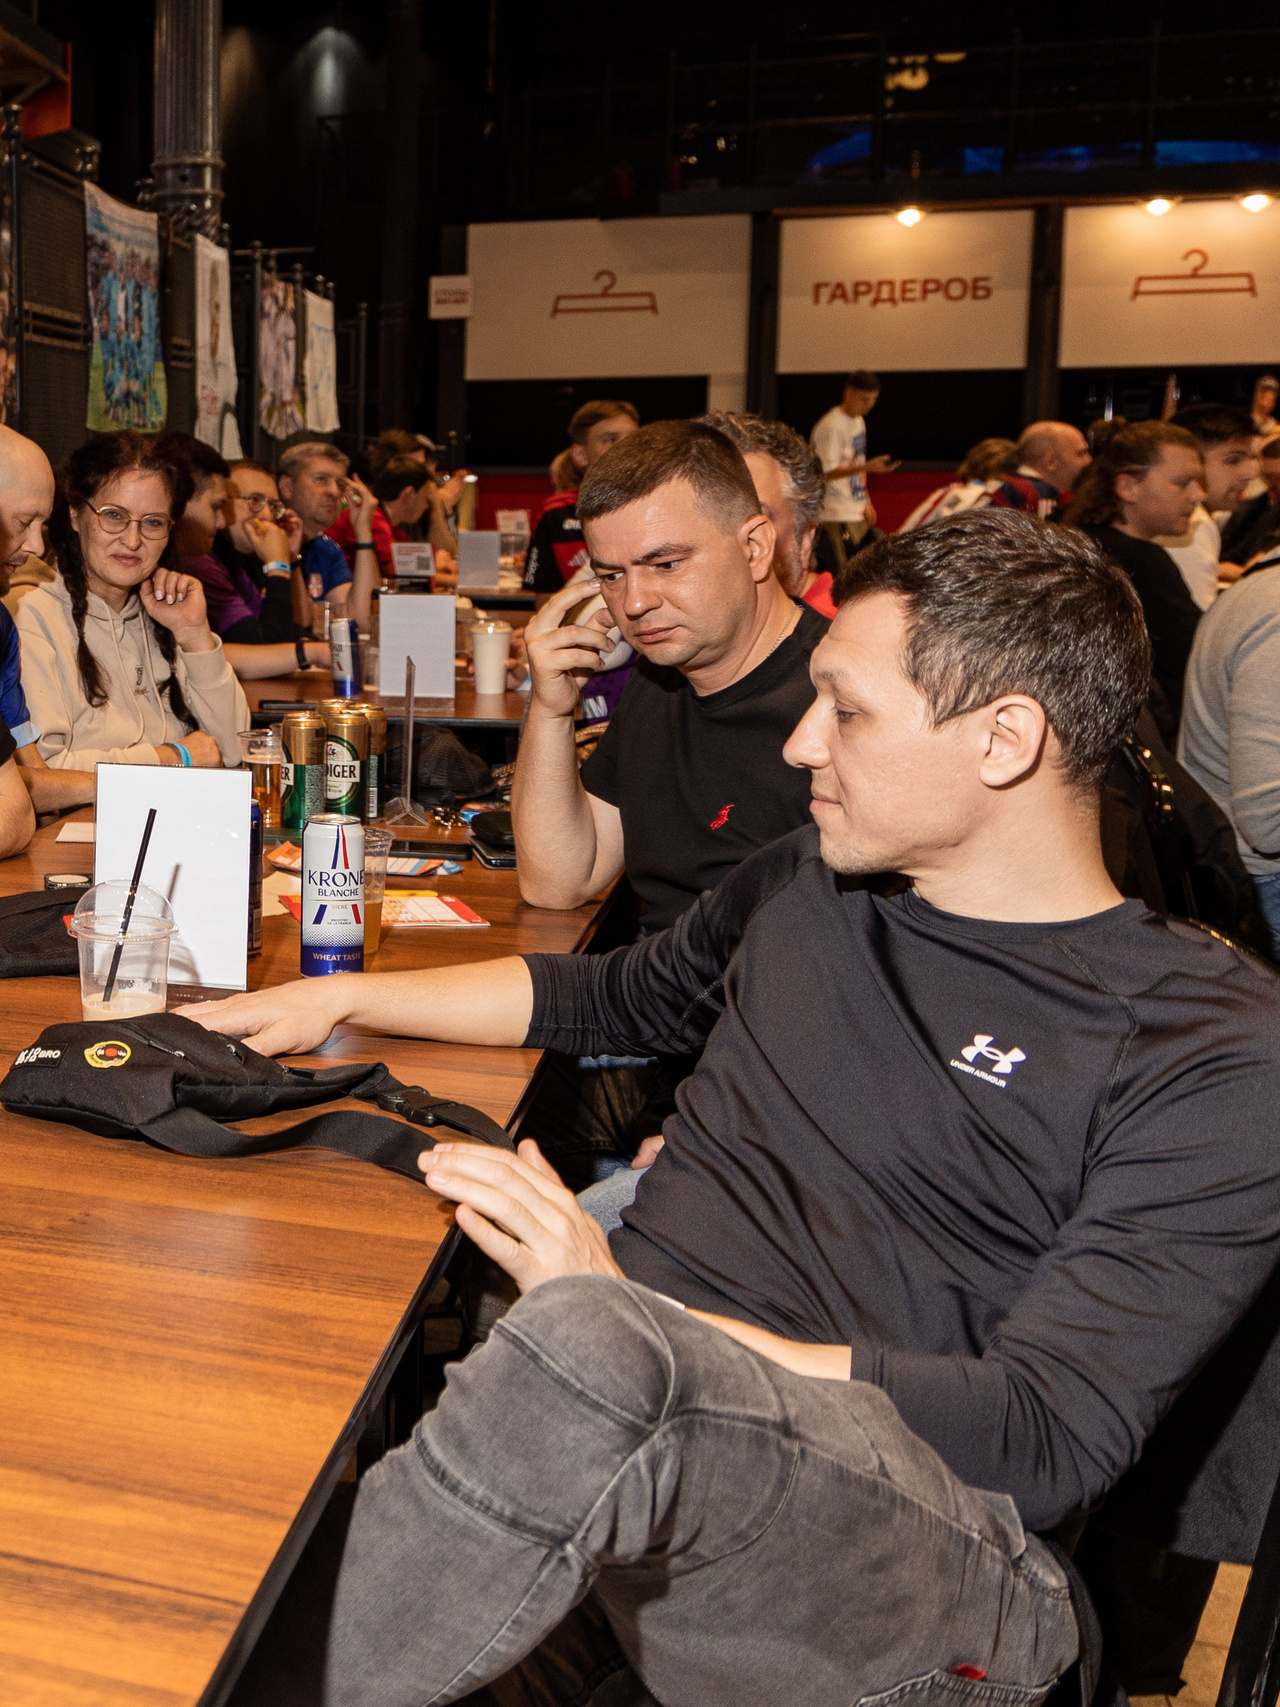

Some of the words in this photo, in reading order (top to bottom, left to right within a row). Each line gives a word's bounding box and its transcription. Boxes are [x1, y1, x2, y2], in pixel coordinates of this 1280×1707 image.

[812, 276, 993, 307] ГАРДЕРОБ
[308, 869, 364, 887] KRONE
[317, 888, 359, 897] BLANCHE
[312, 952, 341, 962] WHEAT
[342, 953, 361, 961] TASTE
[949, 1059, 975, 1074] UNDER
[974, 1069, 1007, 1088] ARMOUR
